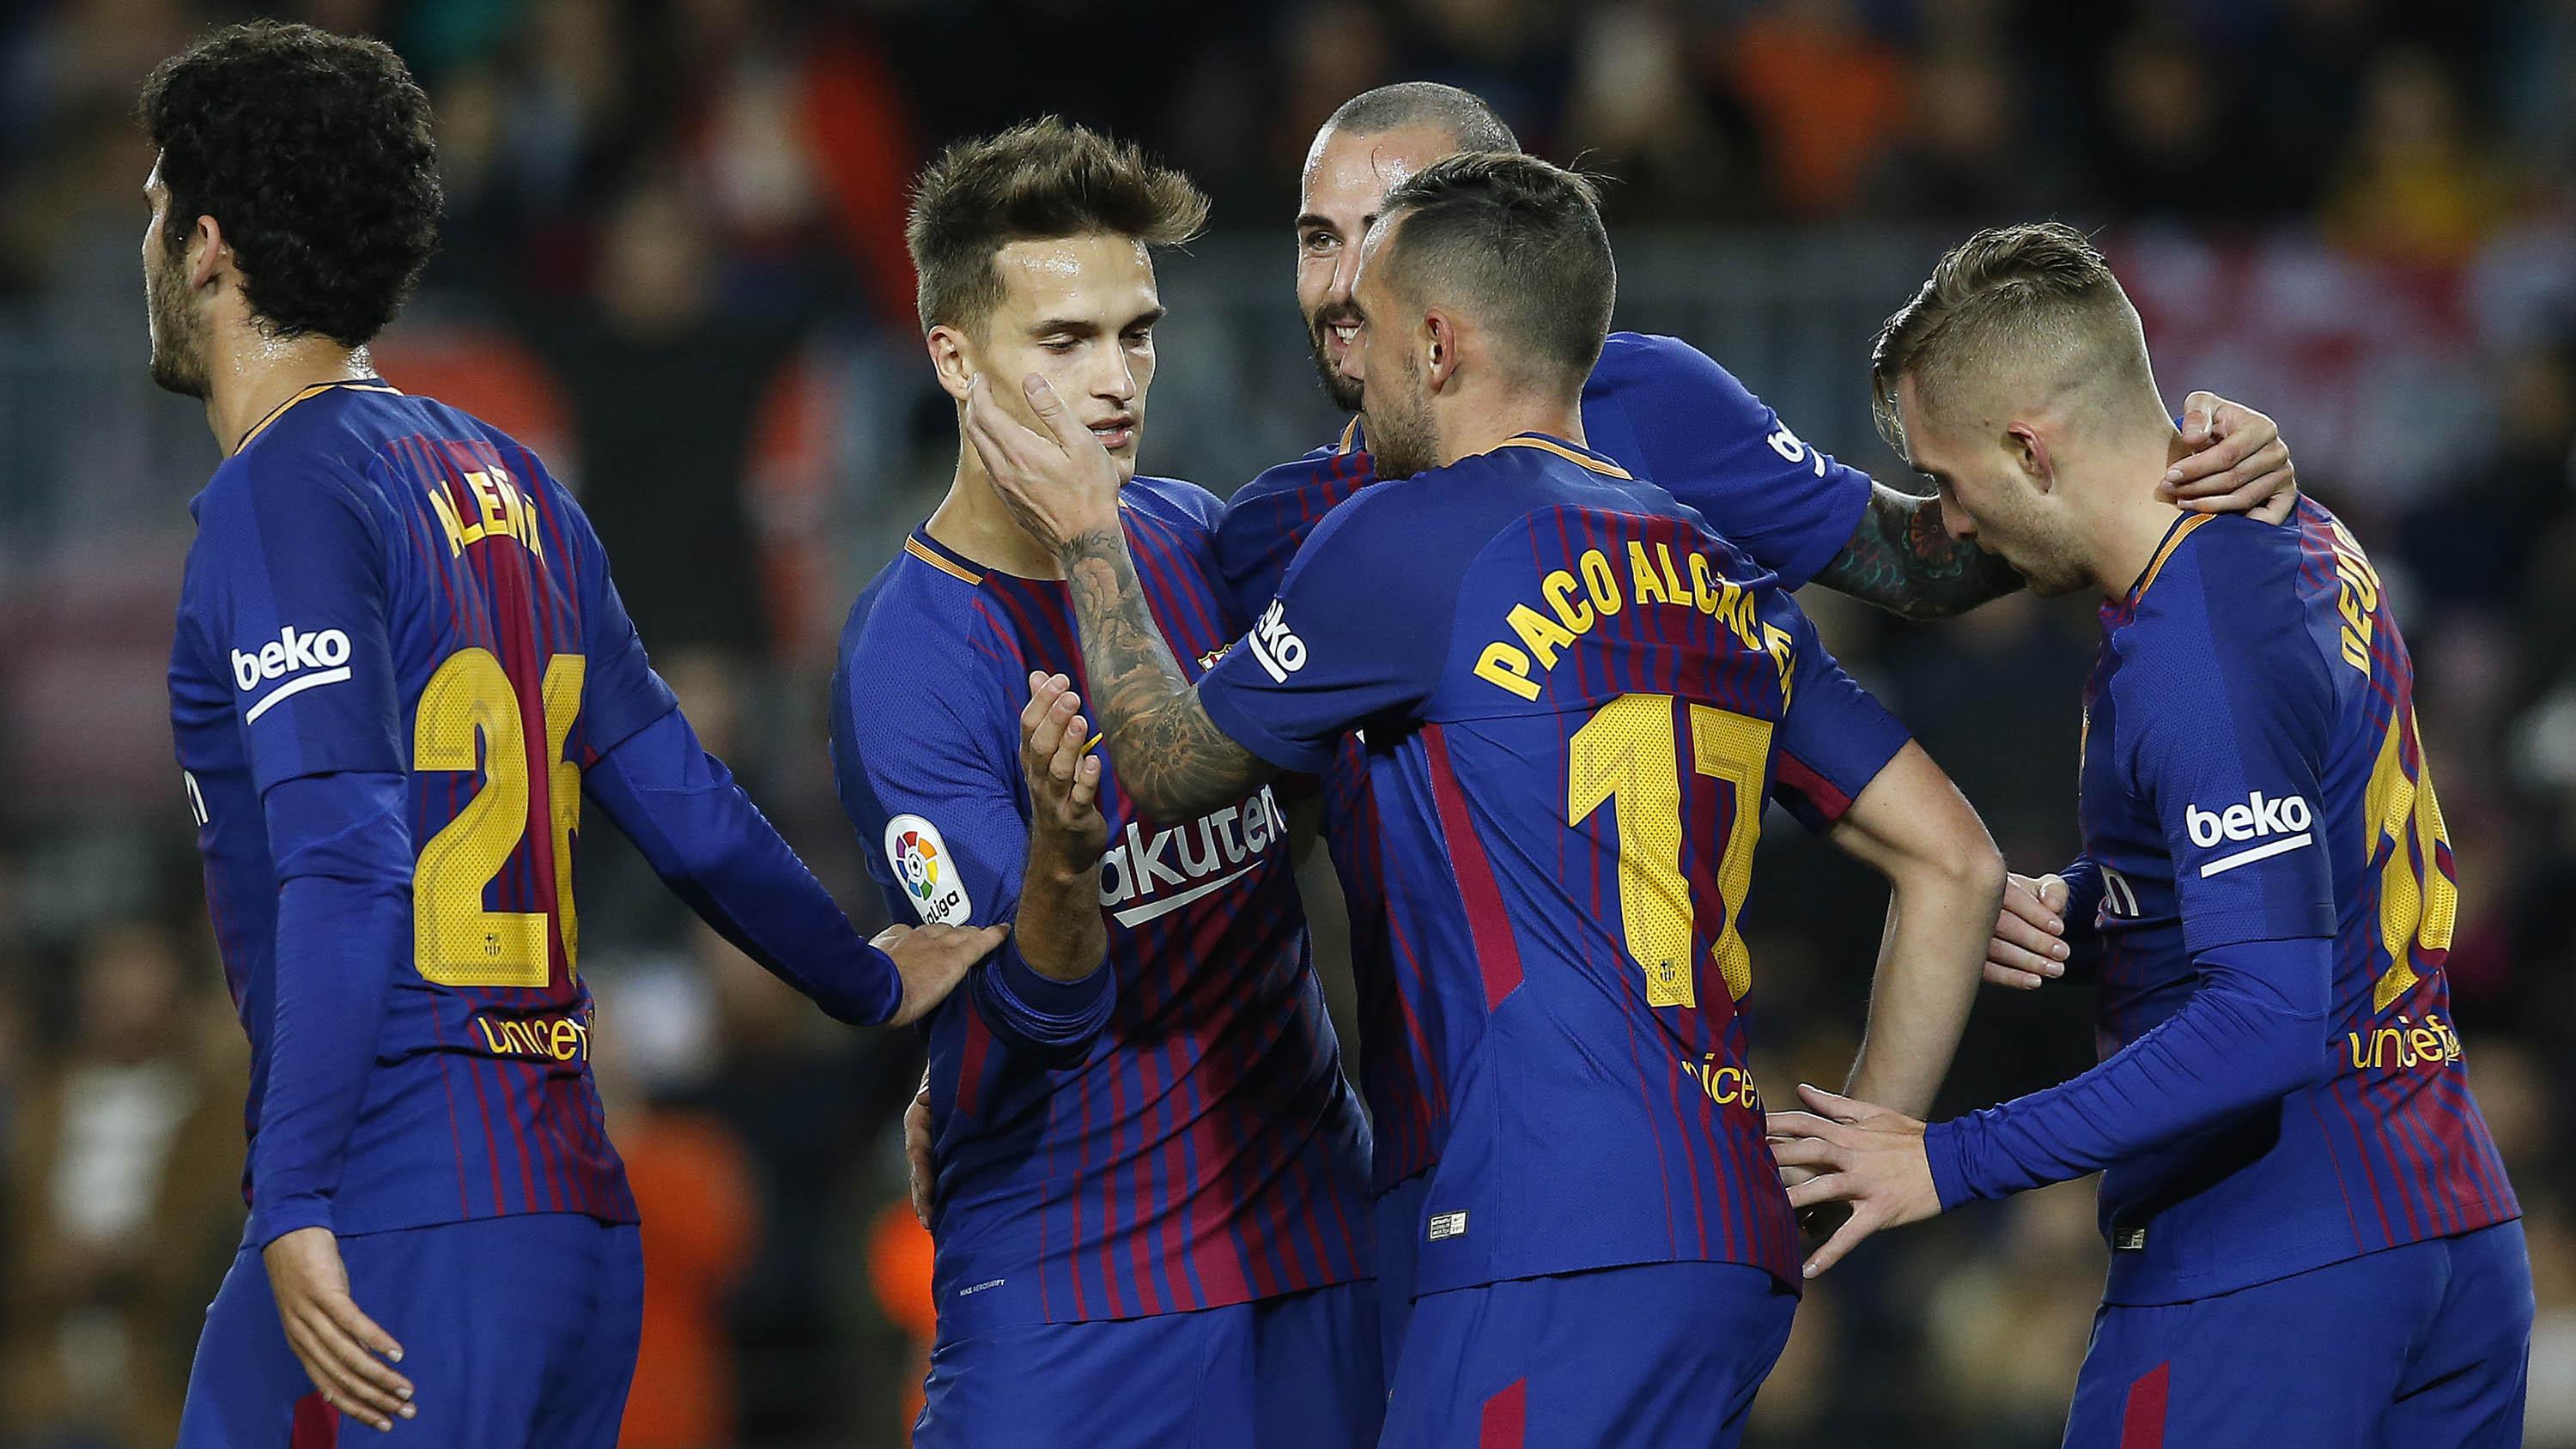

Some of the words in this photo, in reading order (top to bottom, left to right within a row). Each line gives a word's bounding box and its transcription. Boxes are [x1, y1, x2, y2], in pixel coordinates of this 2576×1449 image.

[230, 625, 351, 692] beko
[1259, 598, 1307, 672] eko
[1473, 549, 1622, 702] PACO
[1098, 784, 1288, 906] akuten
[1568, 693, 1775, 1008] 17
[2185, 790, 2312, 850] beko
[2348, 1015, 2449, 1067] unicef
[1681, 1052, 1759, 1111] nice
